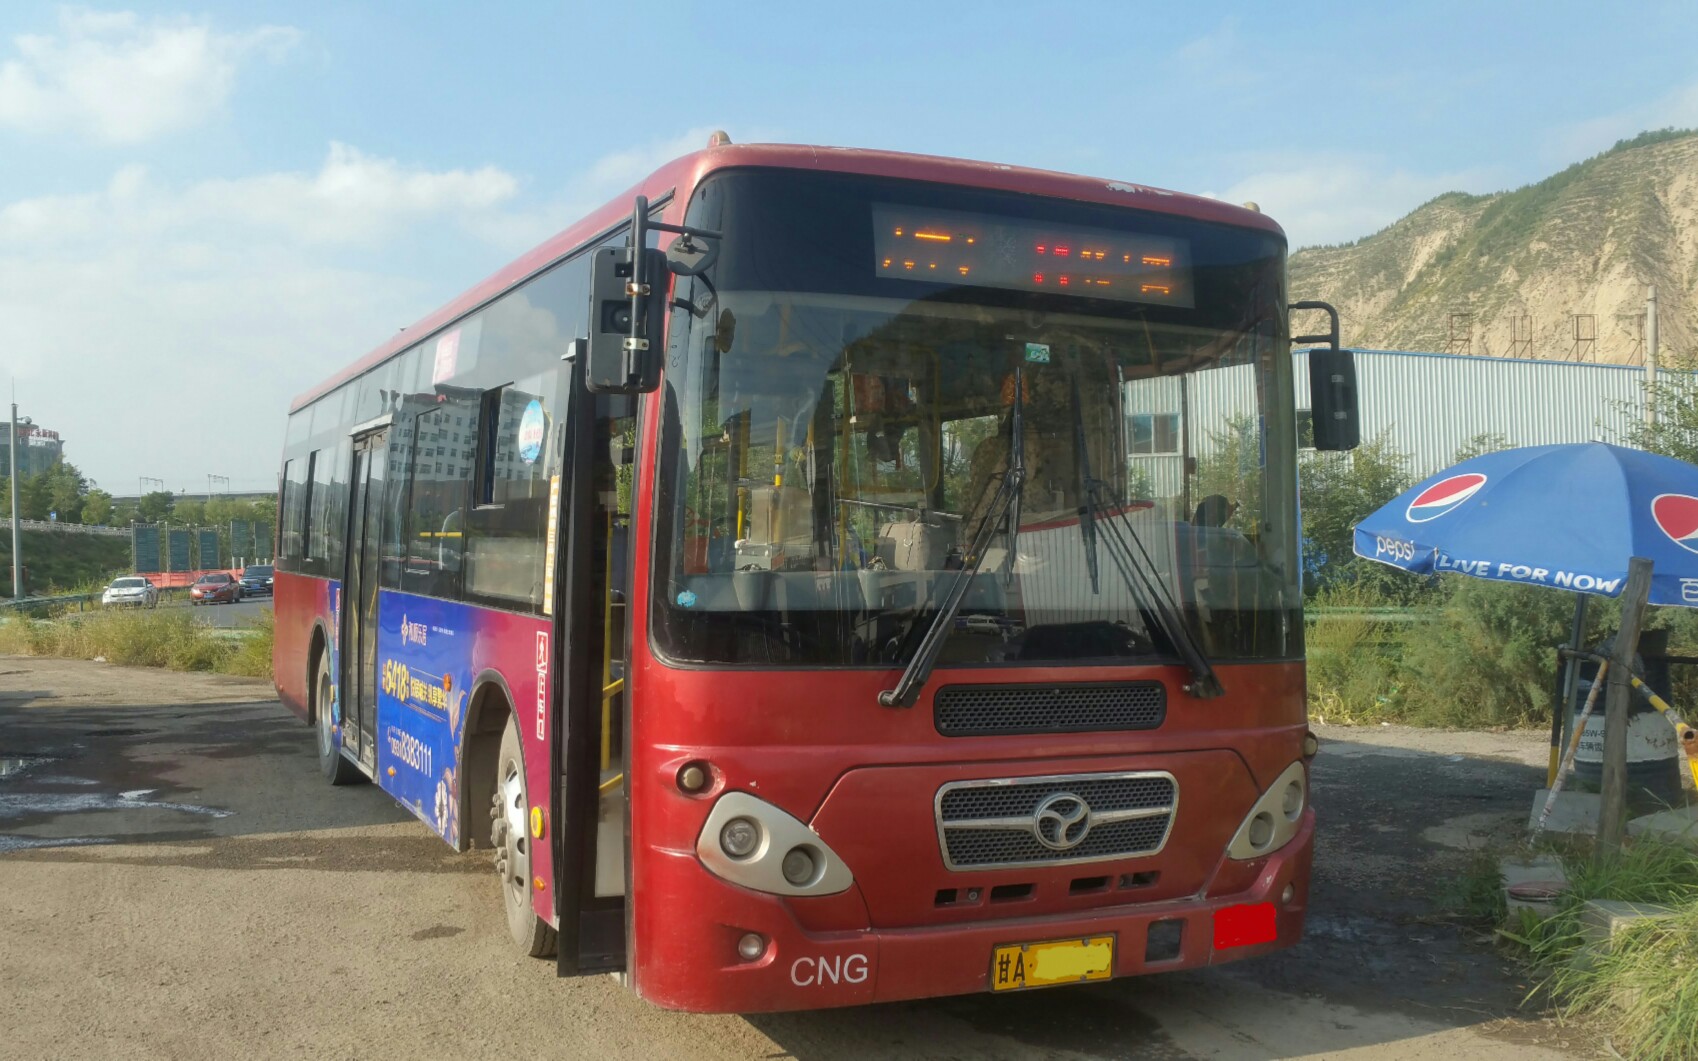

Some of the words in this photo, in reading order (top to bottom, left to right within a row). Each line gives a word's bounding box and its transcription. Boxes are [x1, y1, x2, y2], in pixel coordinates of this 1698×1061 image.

[1376, 536, 1415, 561] pepsi
[1439, 554, 1491, 576] LIVE
[1497, 563, 1549, 582] FOR
[1554, 571, 1621, 593] NOW
[790, 953, 868, 986] CNG
